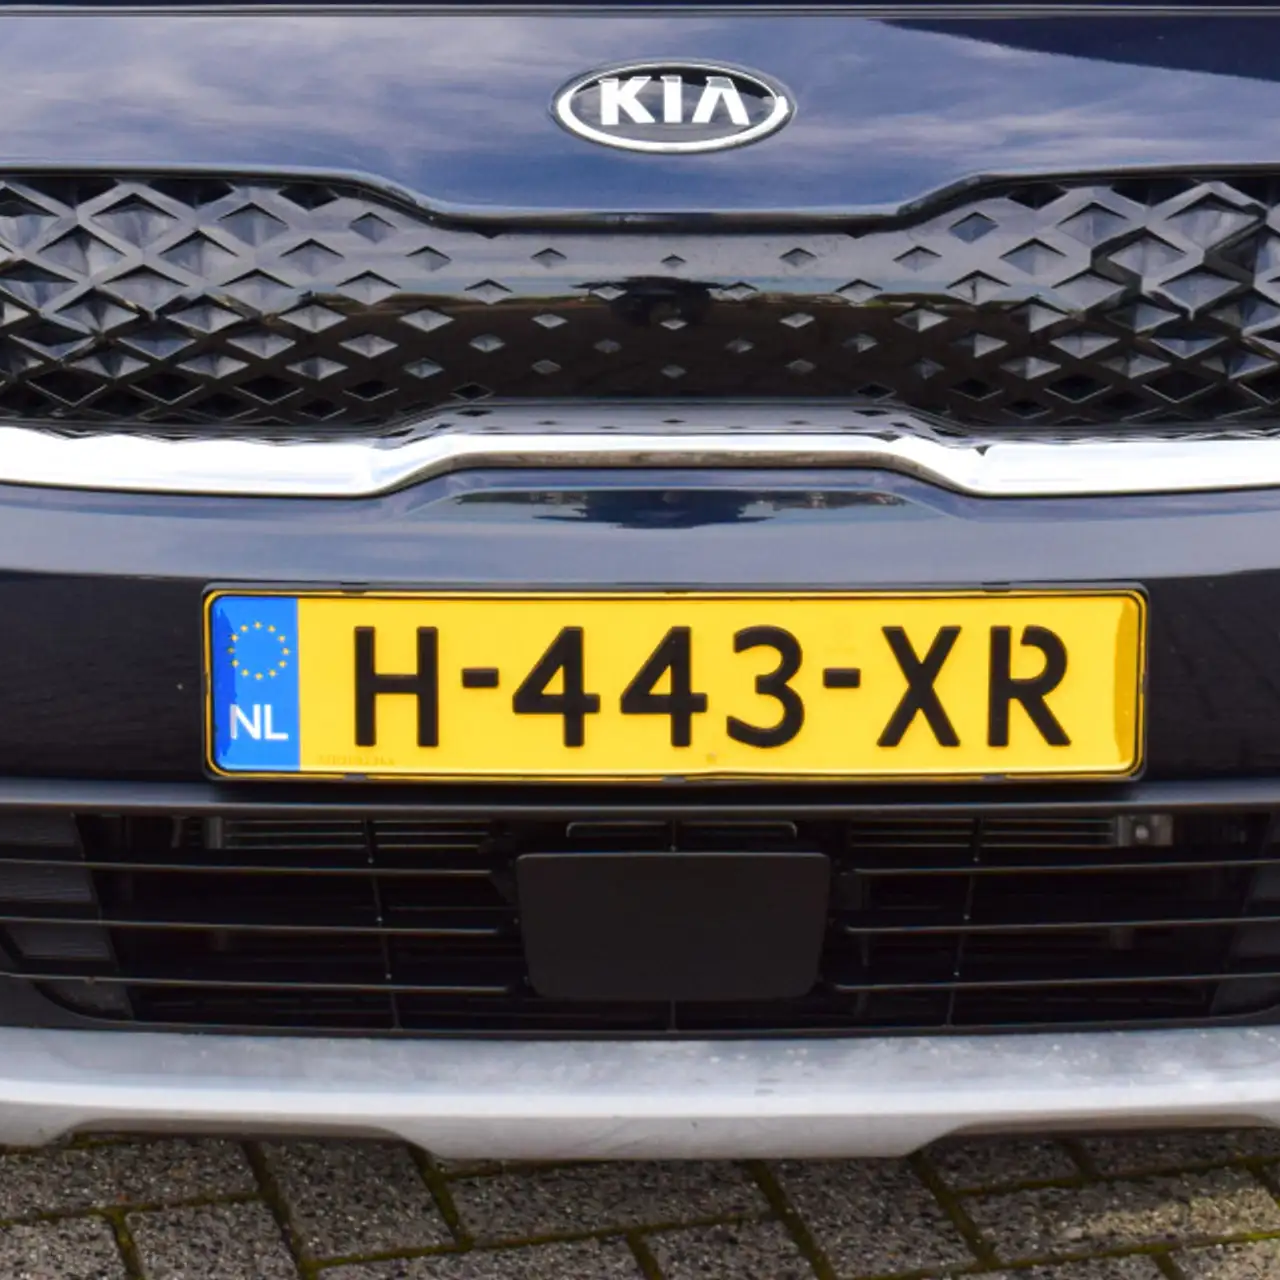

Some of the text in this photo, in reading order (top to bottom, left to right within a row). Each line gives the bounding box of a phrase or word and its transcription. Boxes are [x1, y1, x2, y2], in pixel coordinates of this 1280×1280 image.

[598, 75, 750, 125] KIA
[229, 626, 1071, 749] NL H-443-XR
